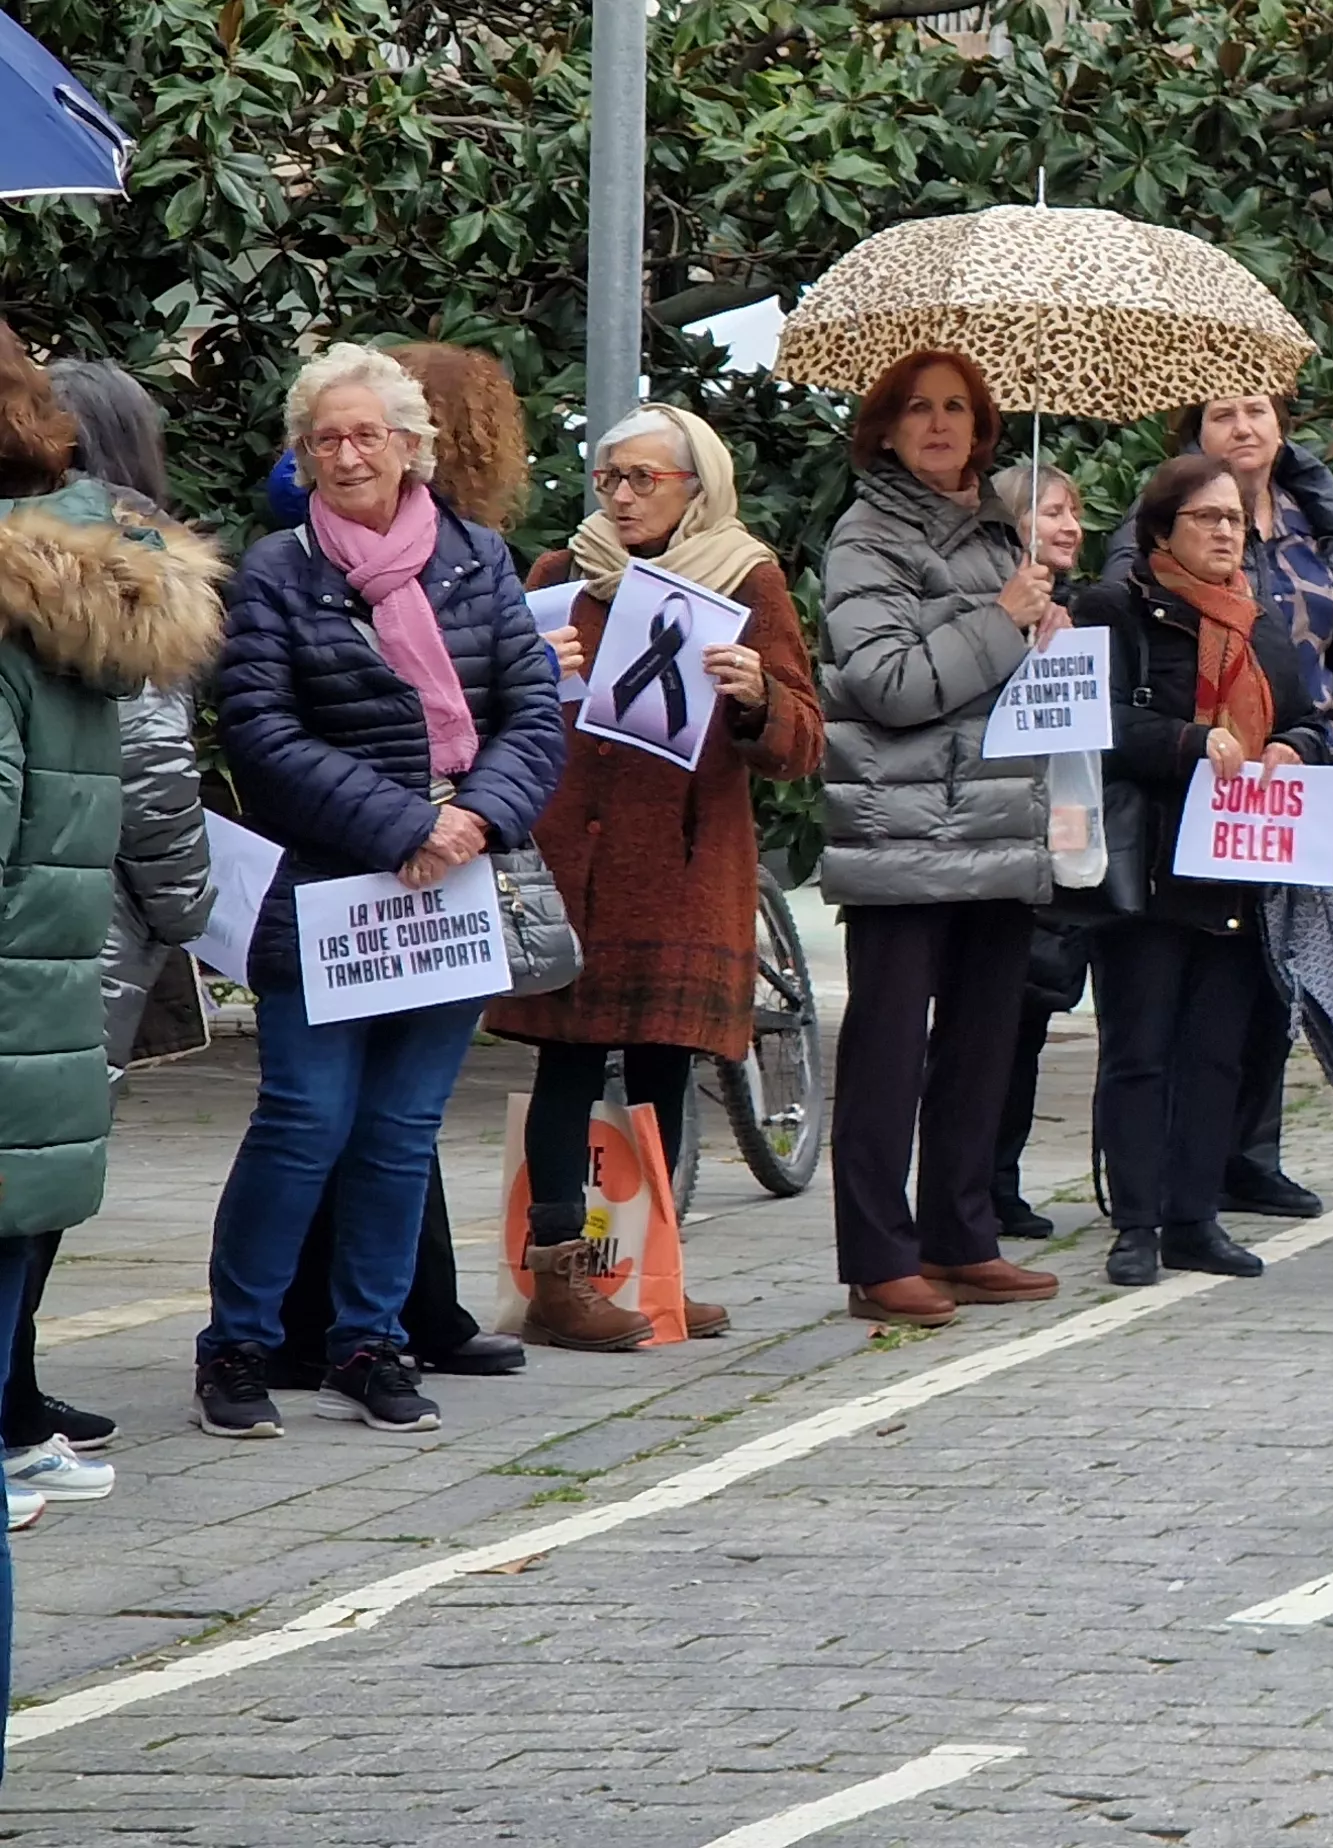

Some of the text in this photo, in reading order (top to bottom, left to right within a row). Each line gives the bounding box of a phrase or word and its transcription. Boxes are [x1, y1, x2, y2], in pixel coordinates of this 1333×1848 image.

[1032, 652, 1094, 679] VOCACIÓN
[1025, 682, 1069, 704] ROMPA
[1074, 680, 1097, 701] POR
[1016, 707, 1072, 730] EL MIEDO
[1211, 776, 1304, 817] SOMOS
[1212, 818, 1294, 863] BELÉN
[349, 889, 446, 928] LA VIDA DE
[318, 910, 490, 961] LAS QUE CUIDAMOS
[325, 940, 492, 988] TAMBIÉN IMPORTA
